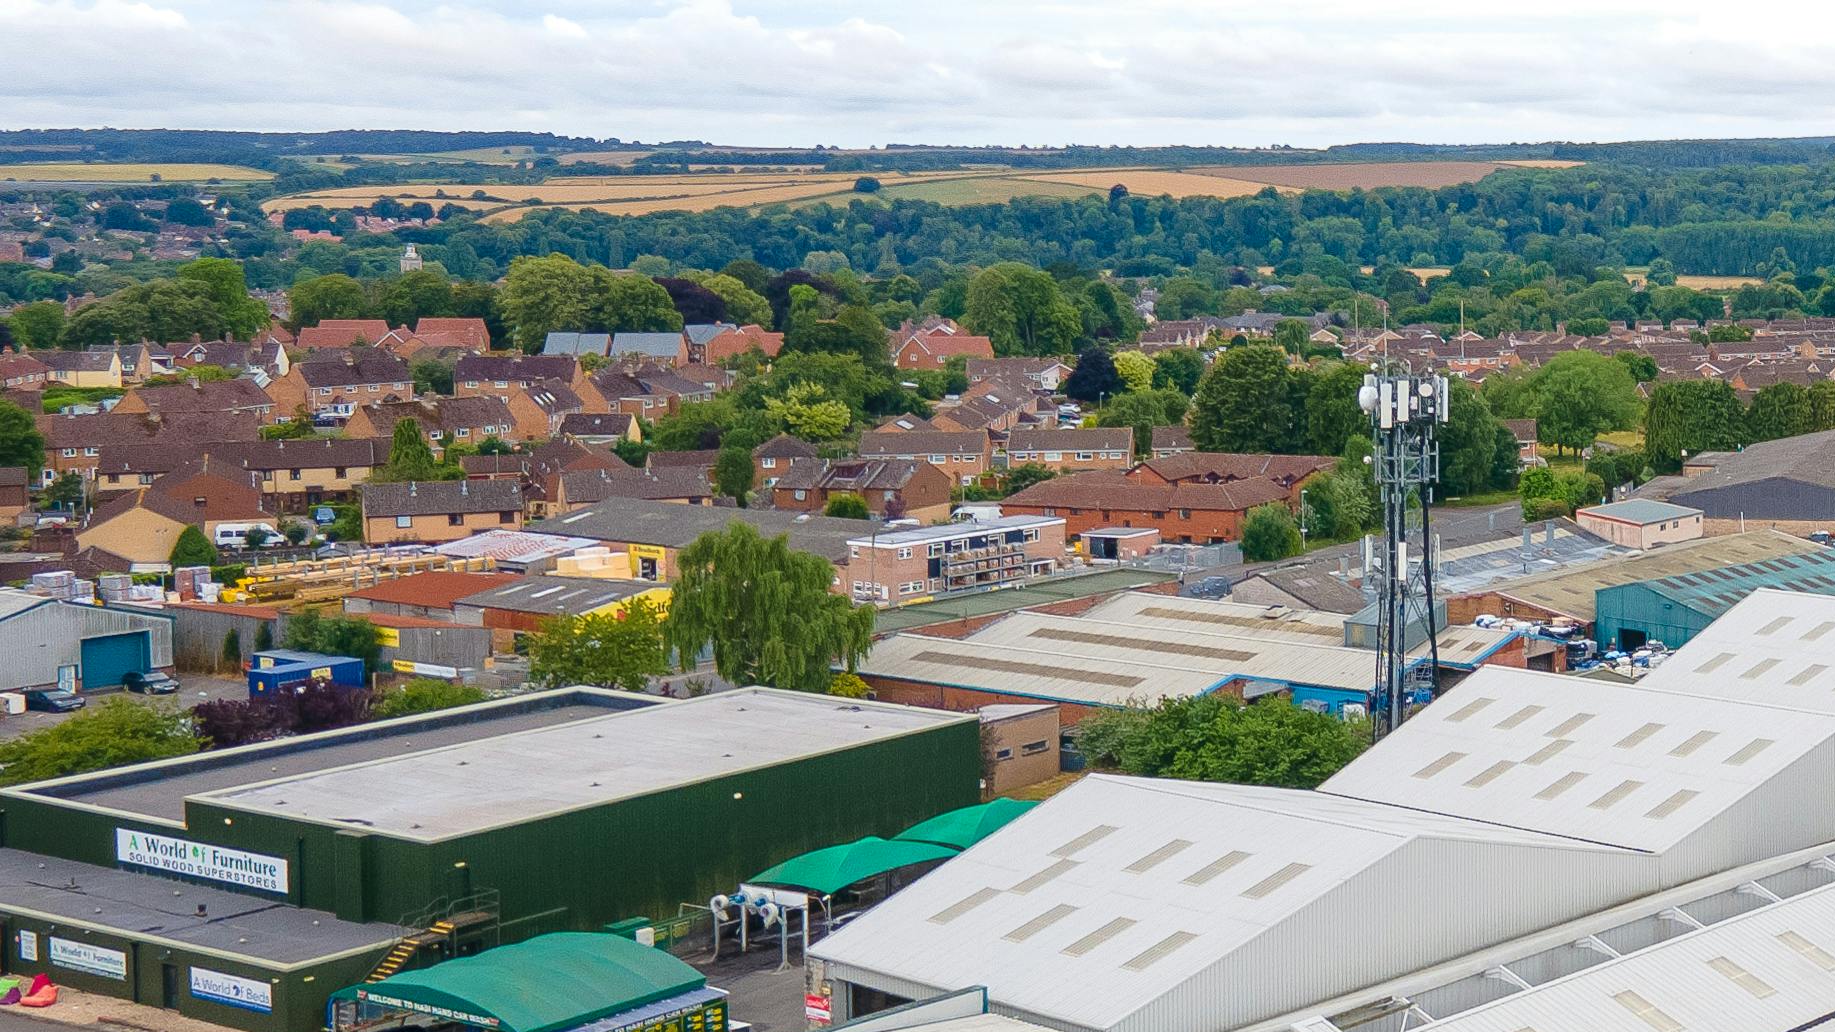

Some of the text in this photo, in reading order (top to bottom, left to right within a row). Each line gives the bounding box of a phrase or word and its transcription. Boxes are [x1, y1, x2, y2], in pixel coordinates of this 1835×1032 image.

[129, 834, 139, 851] A
[145, 837, 187, 859] World
[212, 849, 277, 877] Furniture
[129, 852, 278, 890] SOLID WOOD SUPERSTORES
[193, 976, 201, 988] A
[202, 979, 231, 995] World
[246, 988, 270, 1004] Beds
